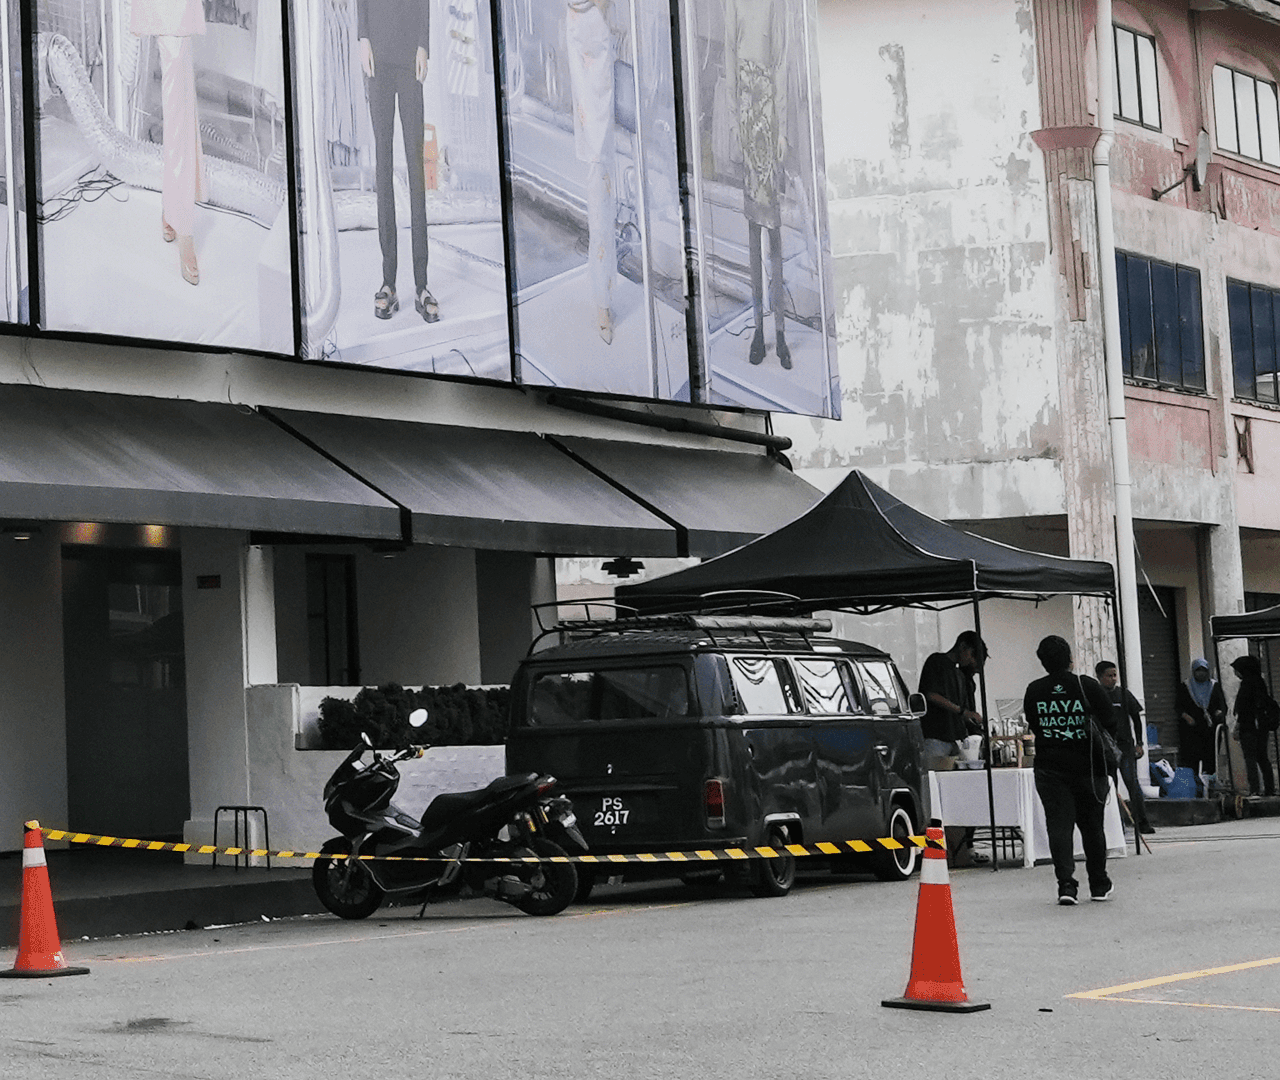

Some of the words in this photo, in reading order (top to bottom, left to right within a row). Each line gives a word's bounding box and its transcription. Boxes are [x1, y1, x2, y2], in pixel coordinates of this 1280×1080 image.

[1036, 700, 1085, 714] RAYA
[1039, 715, 1086, 727] MACAM
[602, 797, 623, 812] PS
[594, 810, 630, 826] 2617
